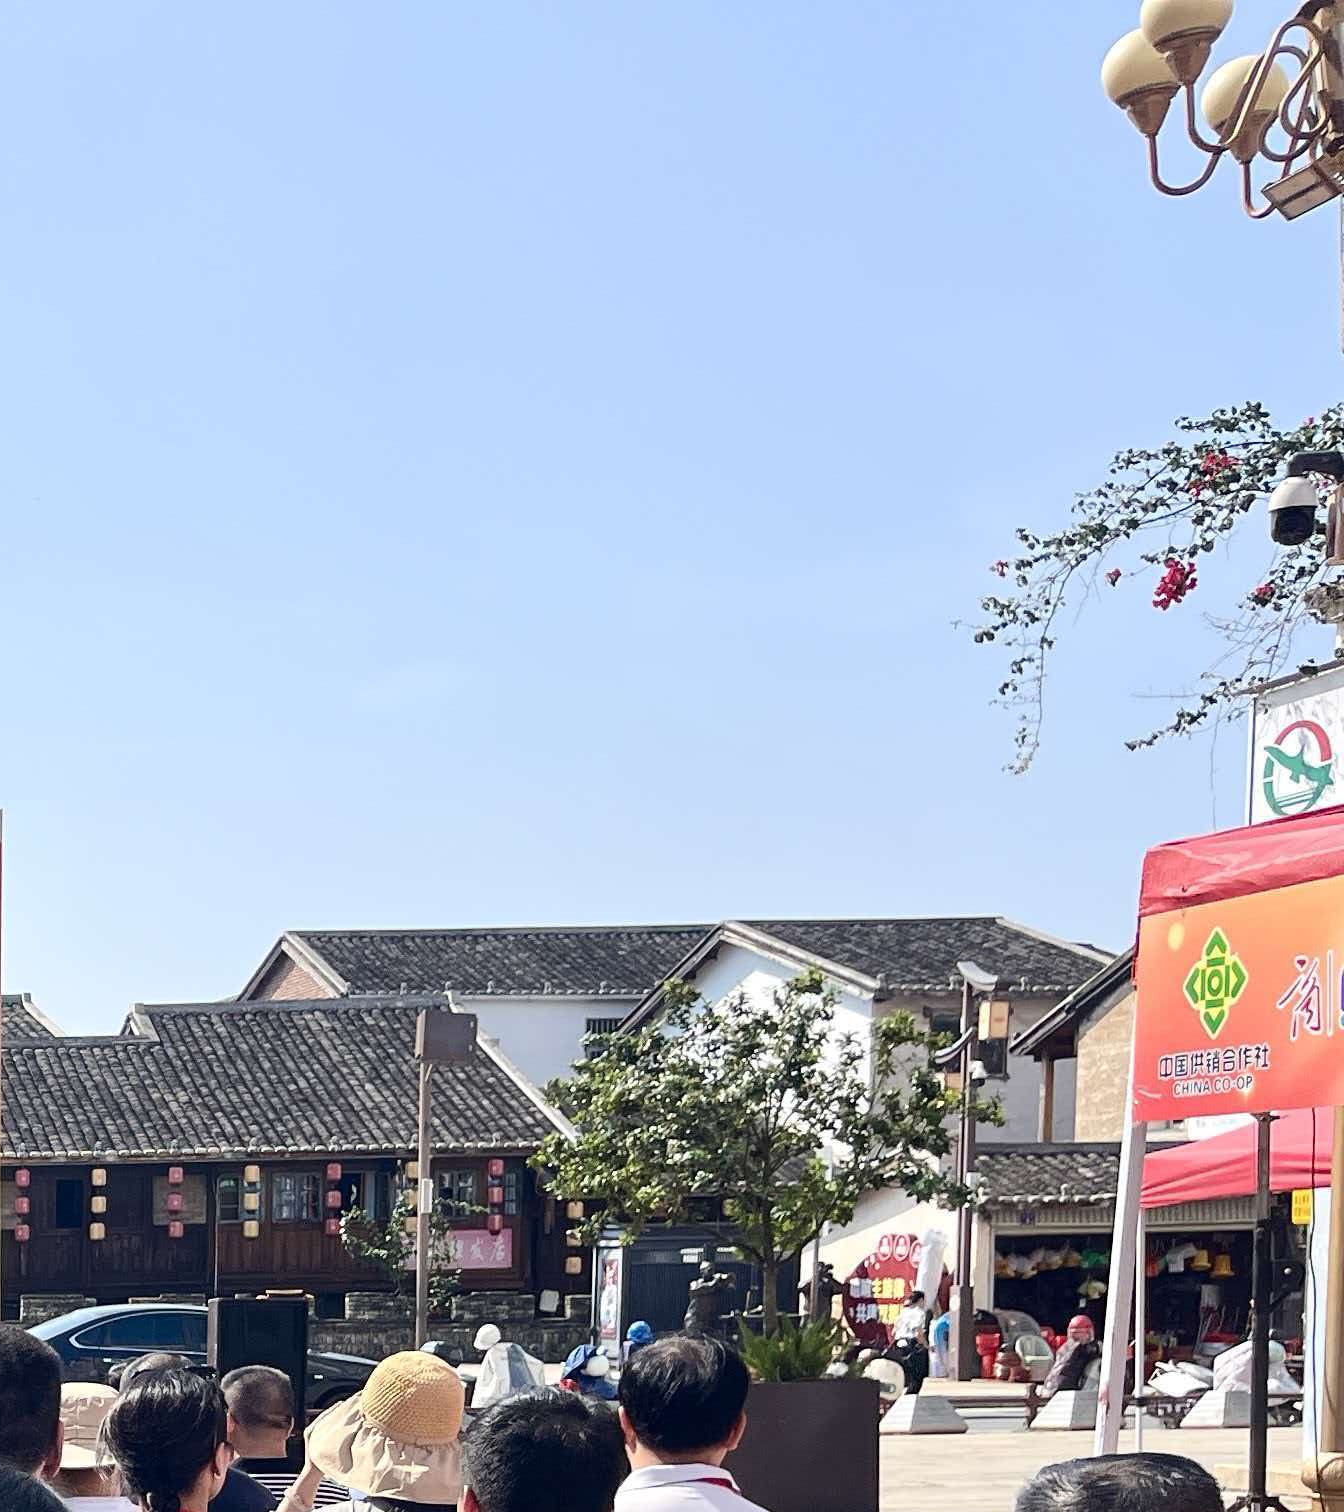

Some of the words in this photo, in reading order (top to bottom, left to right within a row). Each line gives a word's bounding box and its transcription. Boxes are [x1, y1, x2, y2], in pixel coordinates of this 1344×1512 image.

[1159, 1045, 1269, 1078] 中国供销合作社
[1174, 1079, 1210, 1096] CHINA
